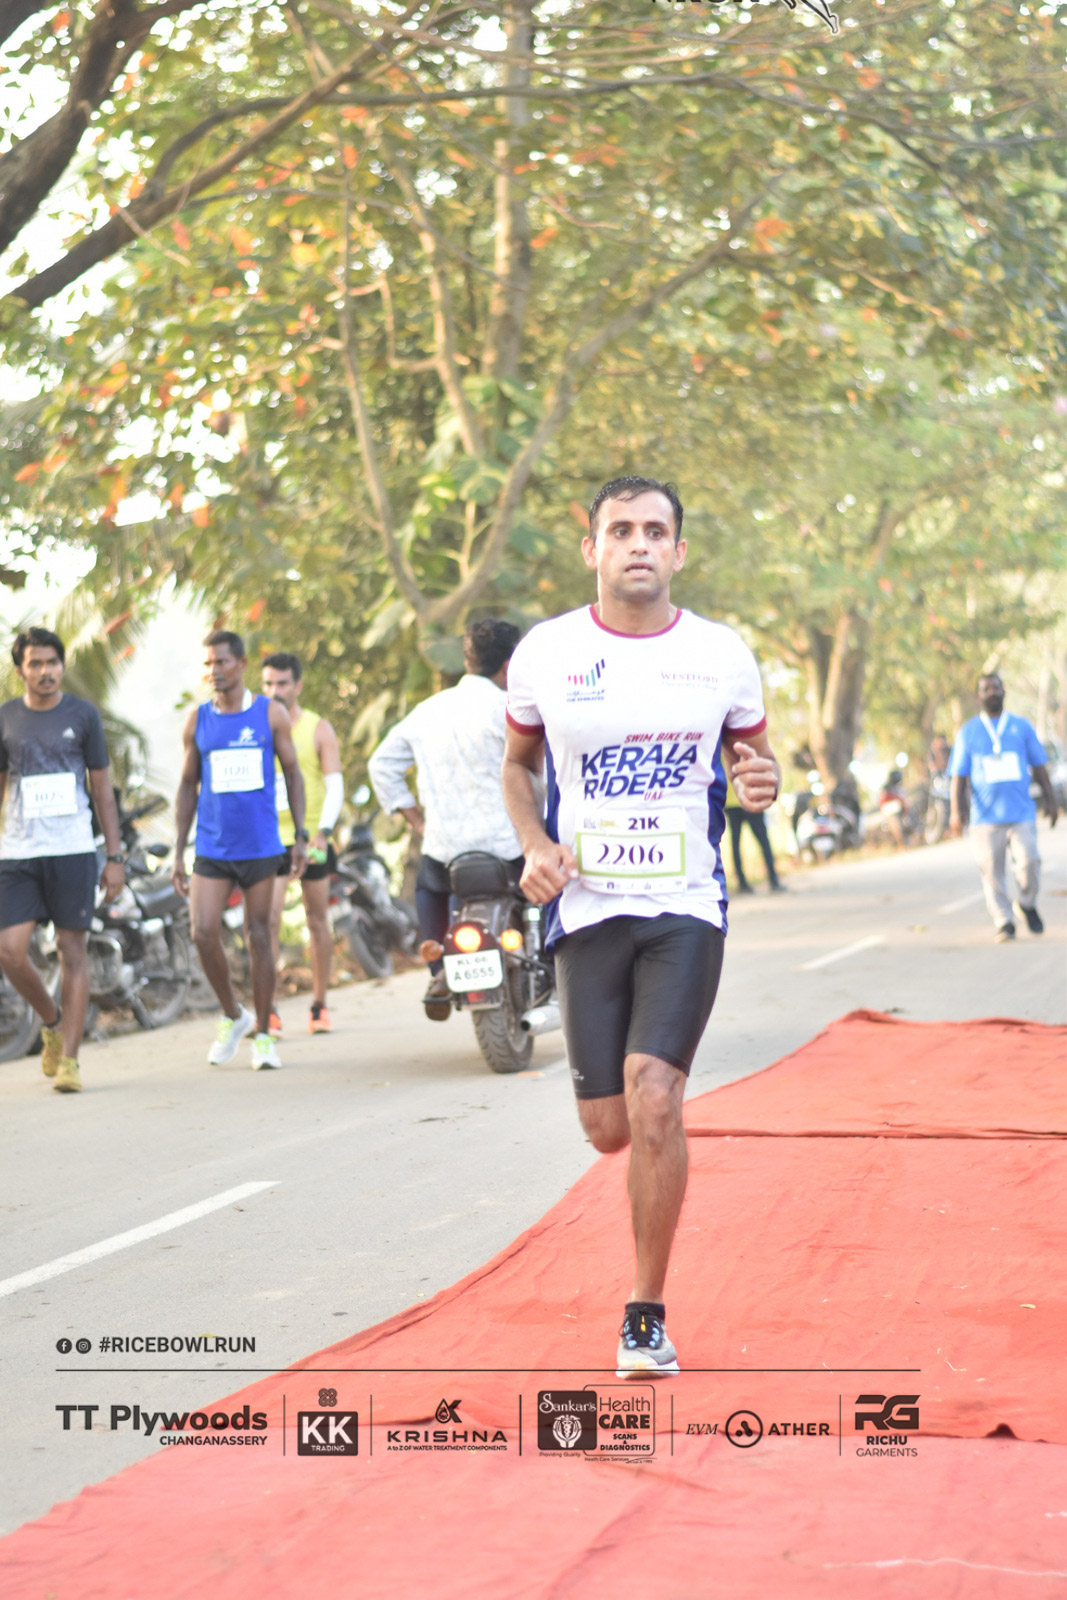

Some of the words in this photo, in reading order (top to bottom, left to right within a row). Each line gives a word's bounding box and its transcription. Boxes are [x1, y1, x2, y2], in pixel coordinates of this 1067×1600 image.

[624, 733, 654, 744] SWIM
[656, 732, 681, 742] BIKE
[683, 732, 704, 741] RUN
[581, 743, 698, 778] KERALA
[584, 766, 690, 800] RIDERS
[627, 815, 660, 831] 21K
[596, 842, 665, 866] 2206
[457, 958, 471, 966] KL
[454, 970, 462, 981] A
[464, 966, 496, 980] 6555
